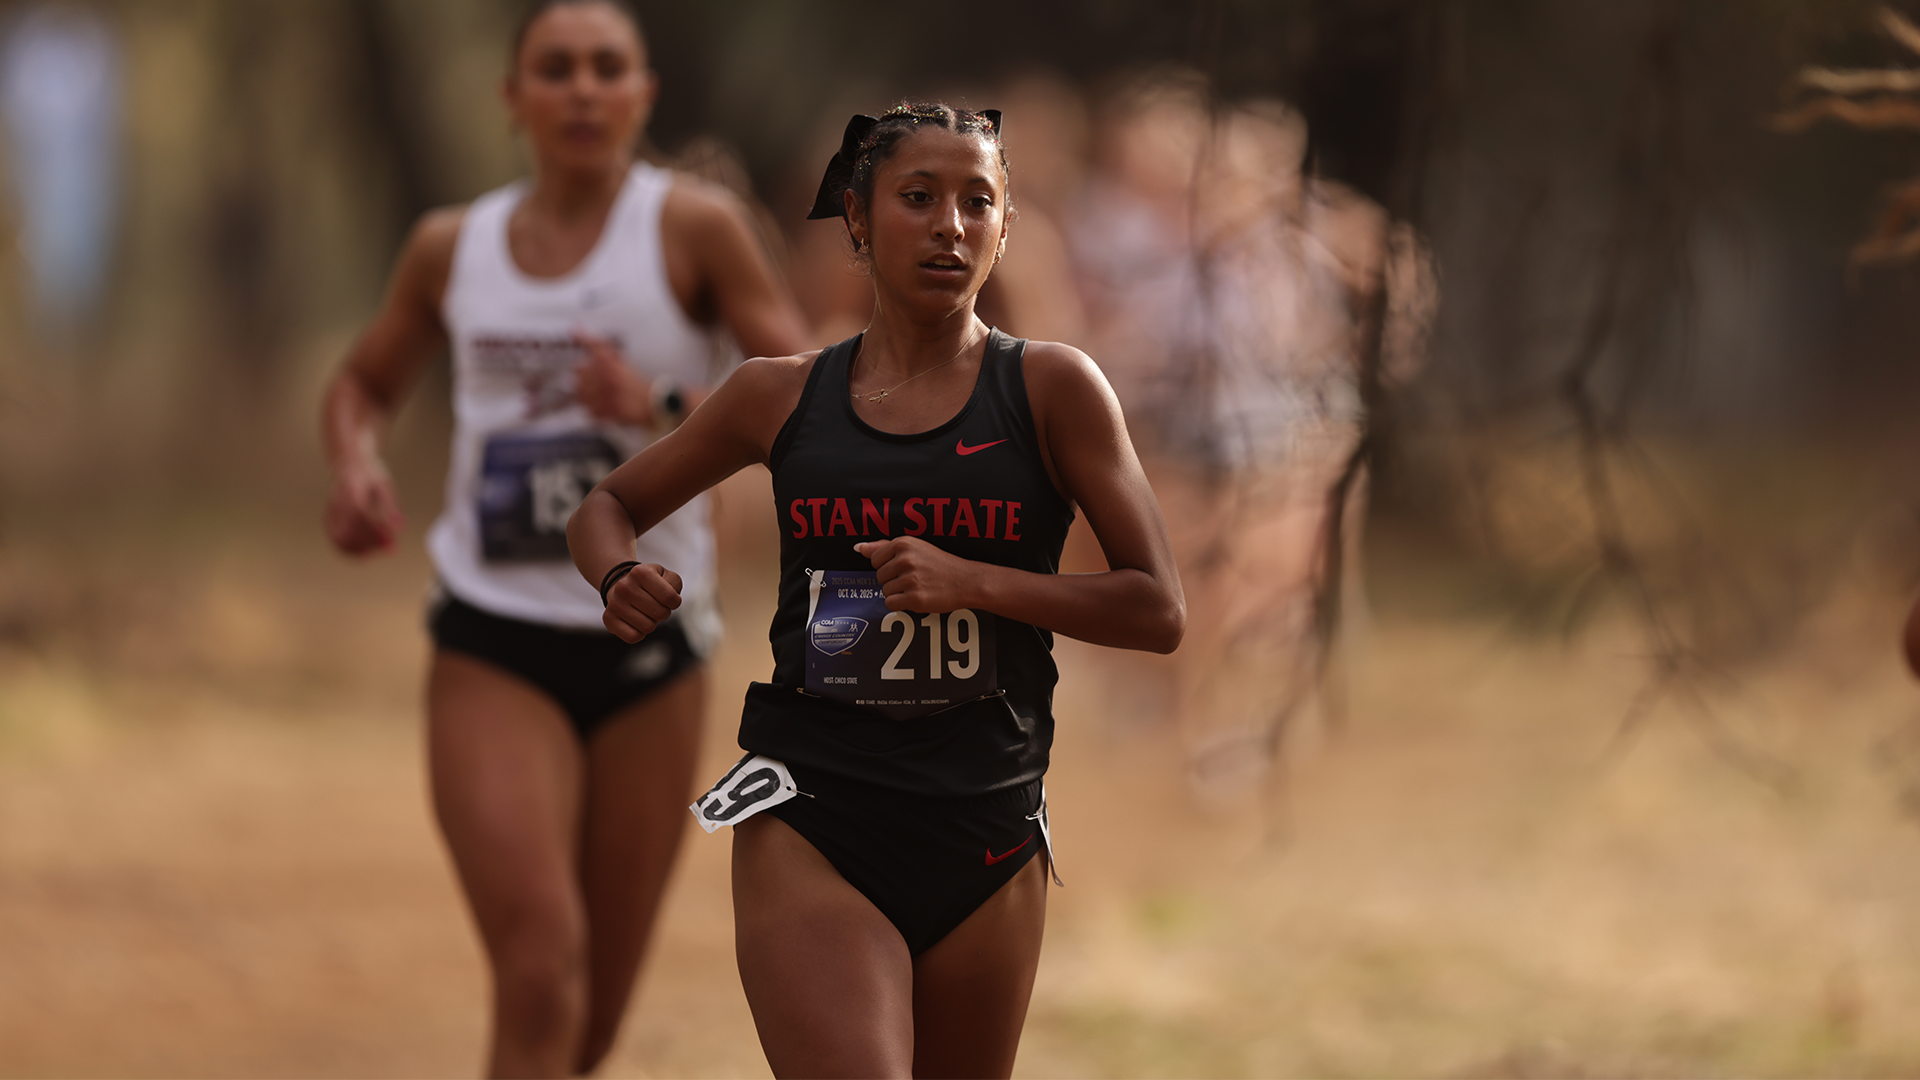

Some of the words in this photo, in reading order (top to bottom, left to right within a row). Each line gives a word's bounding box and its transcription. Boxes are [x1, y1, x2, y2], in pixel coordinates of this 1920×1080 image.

[790, 497, 891, 539] STAN
[903, 497, 1022, 541] STATE
[860, 589, 873, 598] 2025
[880, 608, 980, 680] 219
[834, 676, 846, 684] CHICO
[846, 676, 858, 685] STATE
